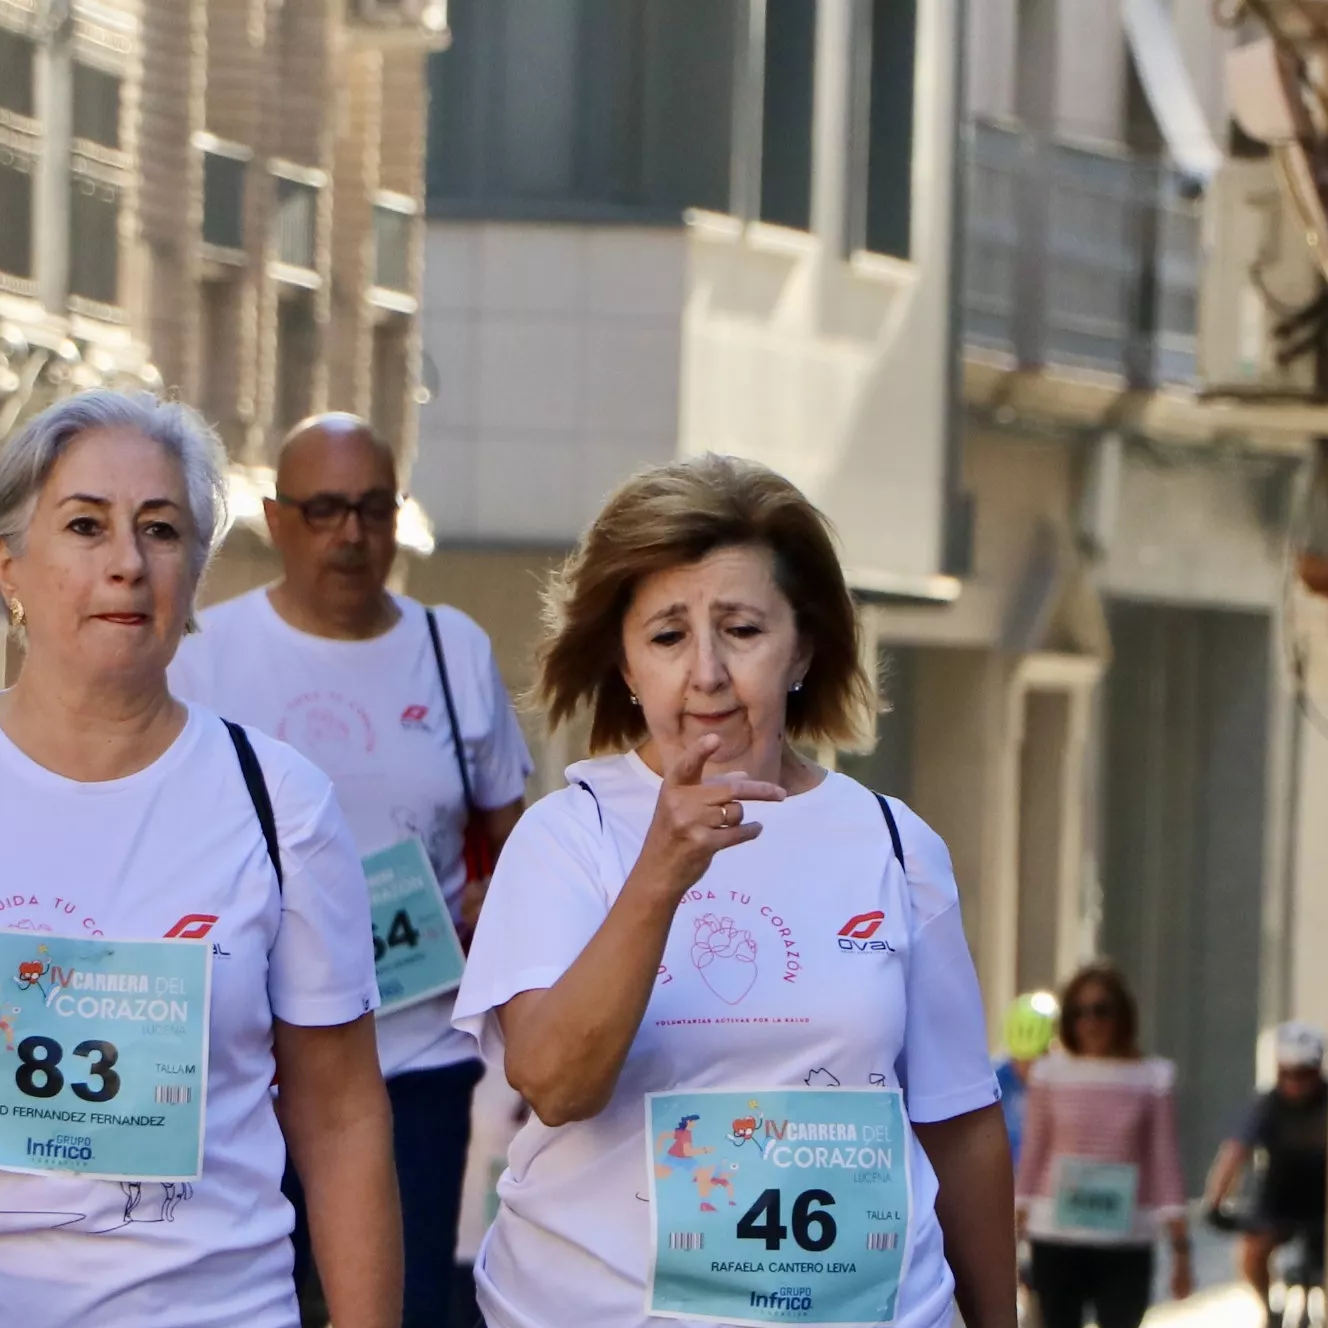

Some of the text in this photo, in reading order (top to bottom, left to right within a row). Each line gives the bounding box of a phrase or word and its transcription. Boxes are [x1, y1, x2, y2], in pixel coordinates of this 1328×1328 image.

[54, 897, 76, 914] TU
[729, 890, 751, 905] TU
[760, 906, 804, 984] CORAZÓN
[51, 965, 186, 995] IV CARRERA DEL
[141, 1024, 187, 1035] LUCENA
[15, 1035, 121, 1103] 83
[155, 1063, 185, 1075] TALLA
[12, 1106, 86, 1123] FERNANDEZ
[90, 1113, 165, 1127] FERNANDEZ
[765, 1119, 892, 1142] IV CARRERA DEL
[27, 1137, 92, 1160] Infrico
[56, 1135, 91, 1146] GRUPO
[853, 1173, 892, 1183] LUCENA
[736, 1188, 837, 1252] 46
[867, 1210, 900, 1220] TALLA L
[711, 1262, 857, 1273] RAFAELA CANTERO LEIVA
[750, 1291, 812, 1310] Infrico
[780, 1287, 811, 1297] GRUPO
